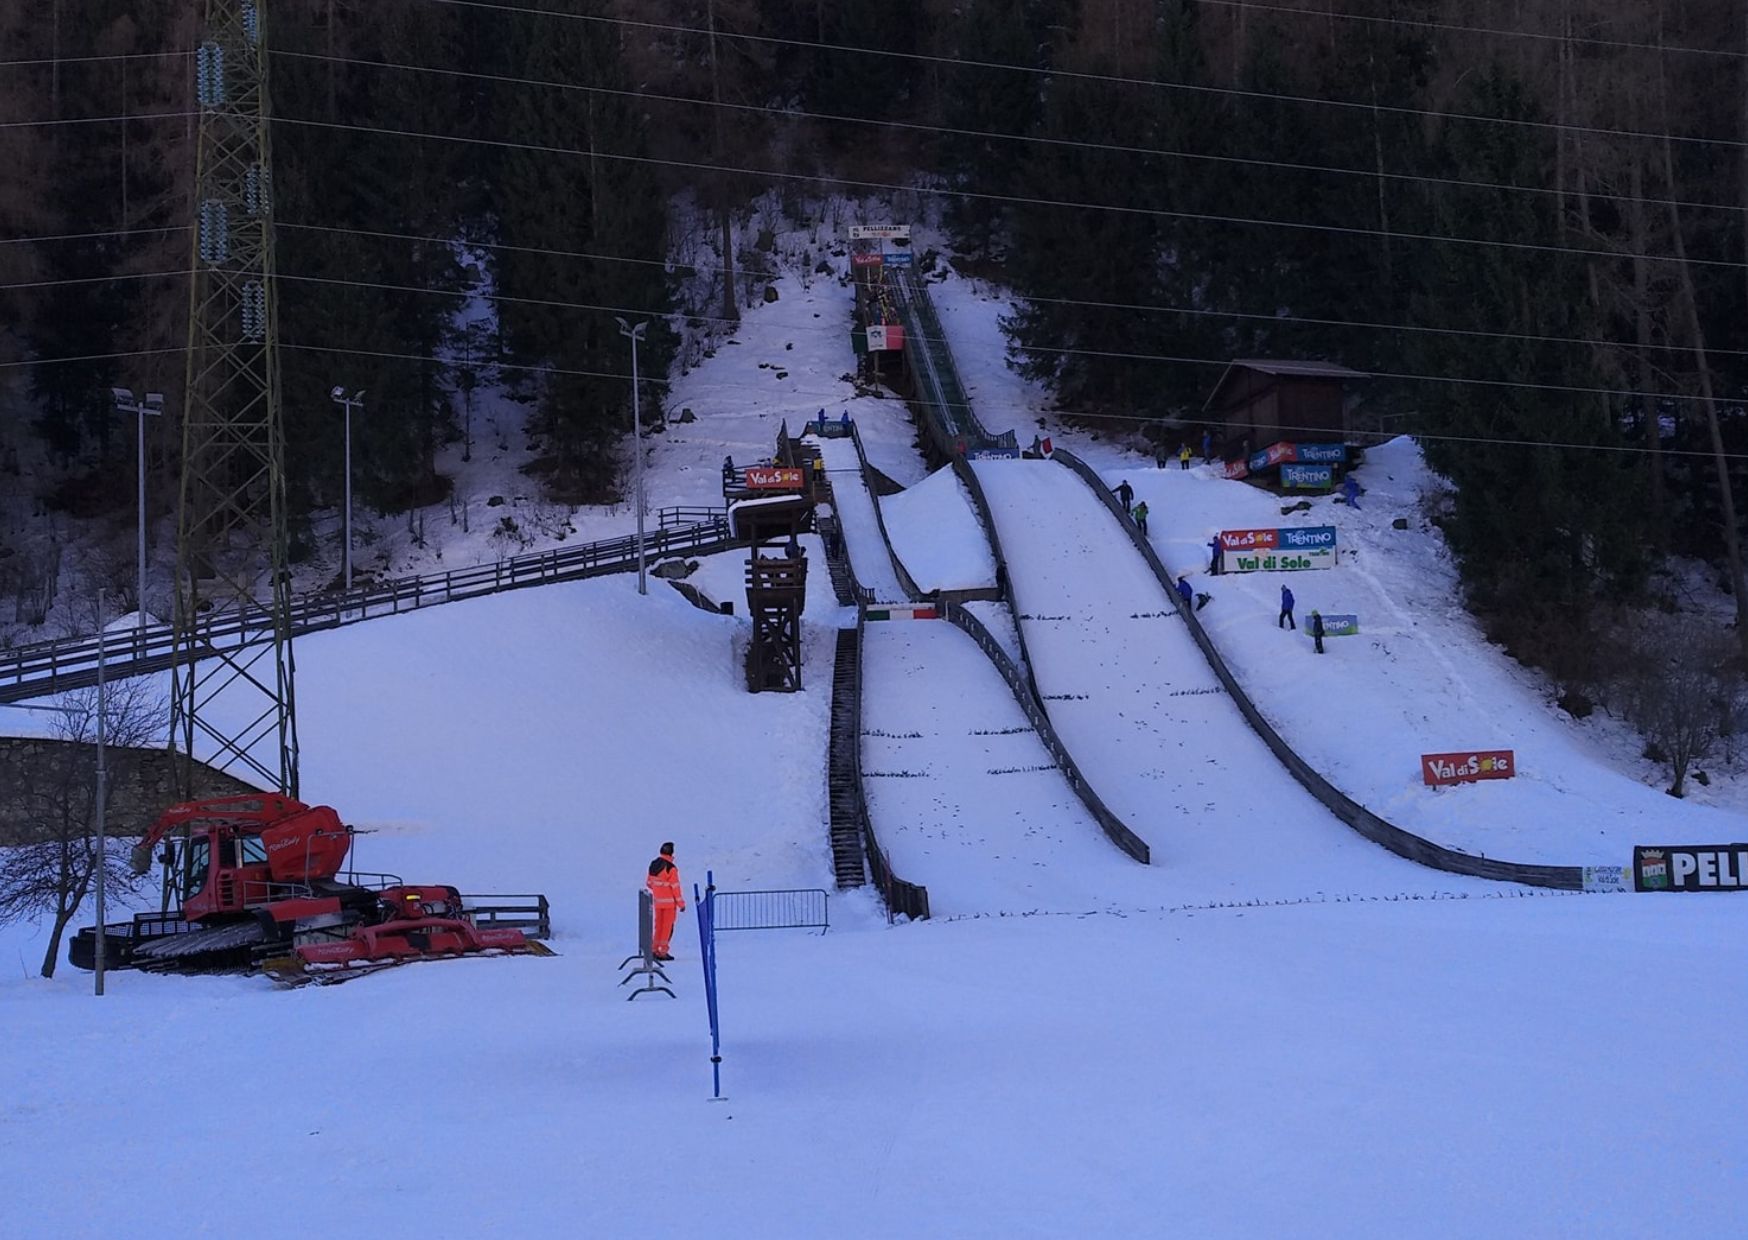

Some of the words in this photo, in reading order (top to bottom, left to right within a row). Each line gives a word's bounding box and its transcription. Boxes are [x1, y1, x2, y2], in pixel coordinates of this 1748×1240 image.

[1287, 467, 1330, 482] TRENTINO
[1222, 535, 1239, 546] Val
[1286, 531, 1331, 545] TRENTINO
[1237, 556, 1260, 569] Val
[1263, 556, 1276, 568] di
[1281, 556, 1311, 569] Sole
[1428, 760, 1456, 780] Val
[1457, 764, 1469, 776] di
